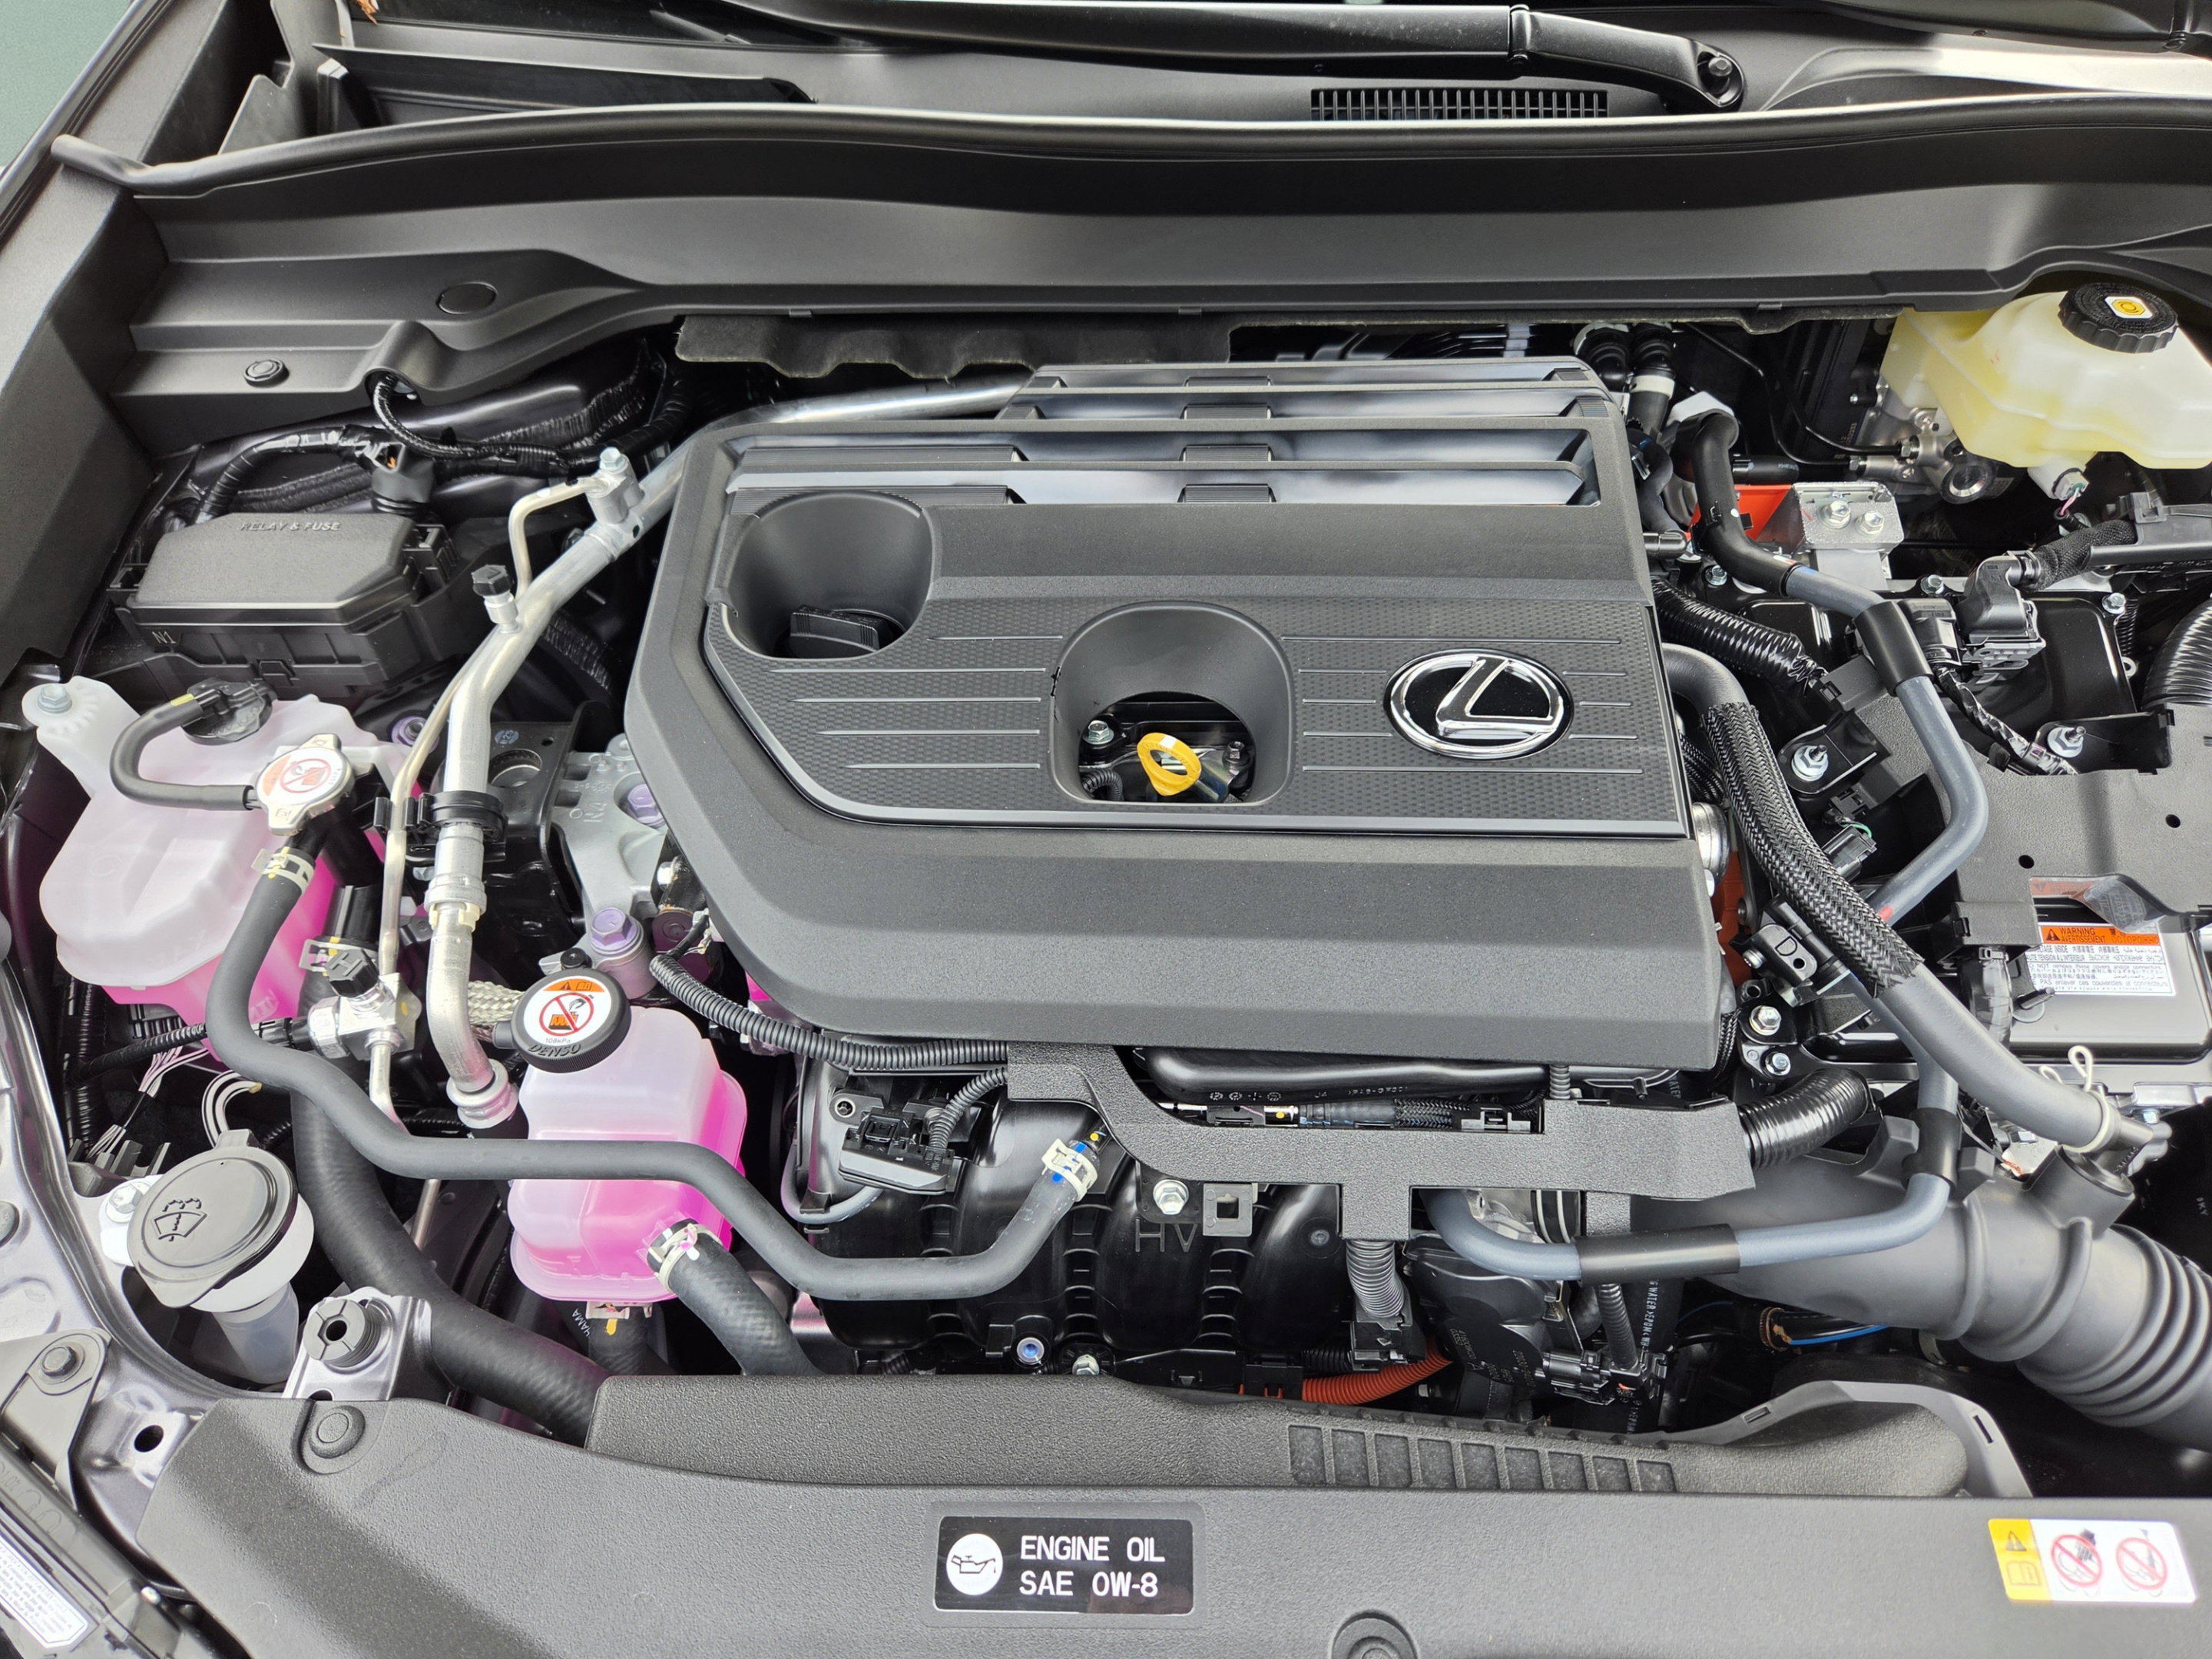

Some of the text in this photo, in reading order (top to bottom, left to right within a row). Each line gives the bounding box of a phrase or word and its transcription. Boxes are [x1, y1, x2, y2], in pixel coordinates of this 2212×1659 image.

[240, 522, 341, 531] RELAY & FUSE
[151, 631, 177, 644] N1
[1774, 935, 1798, 957] D
[329, 952, 363, 977] H
[528, 1044, 581, 1057] DENSO
[1134, 1219, 1198, 1253] HV
[1020, 1535, 1165, 1562] ENGINE OIL
[1019, 1570, 1074, 1596] SAE
